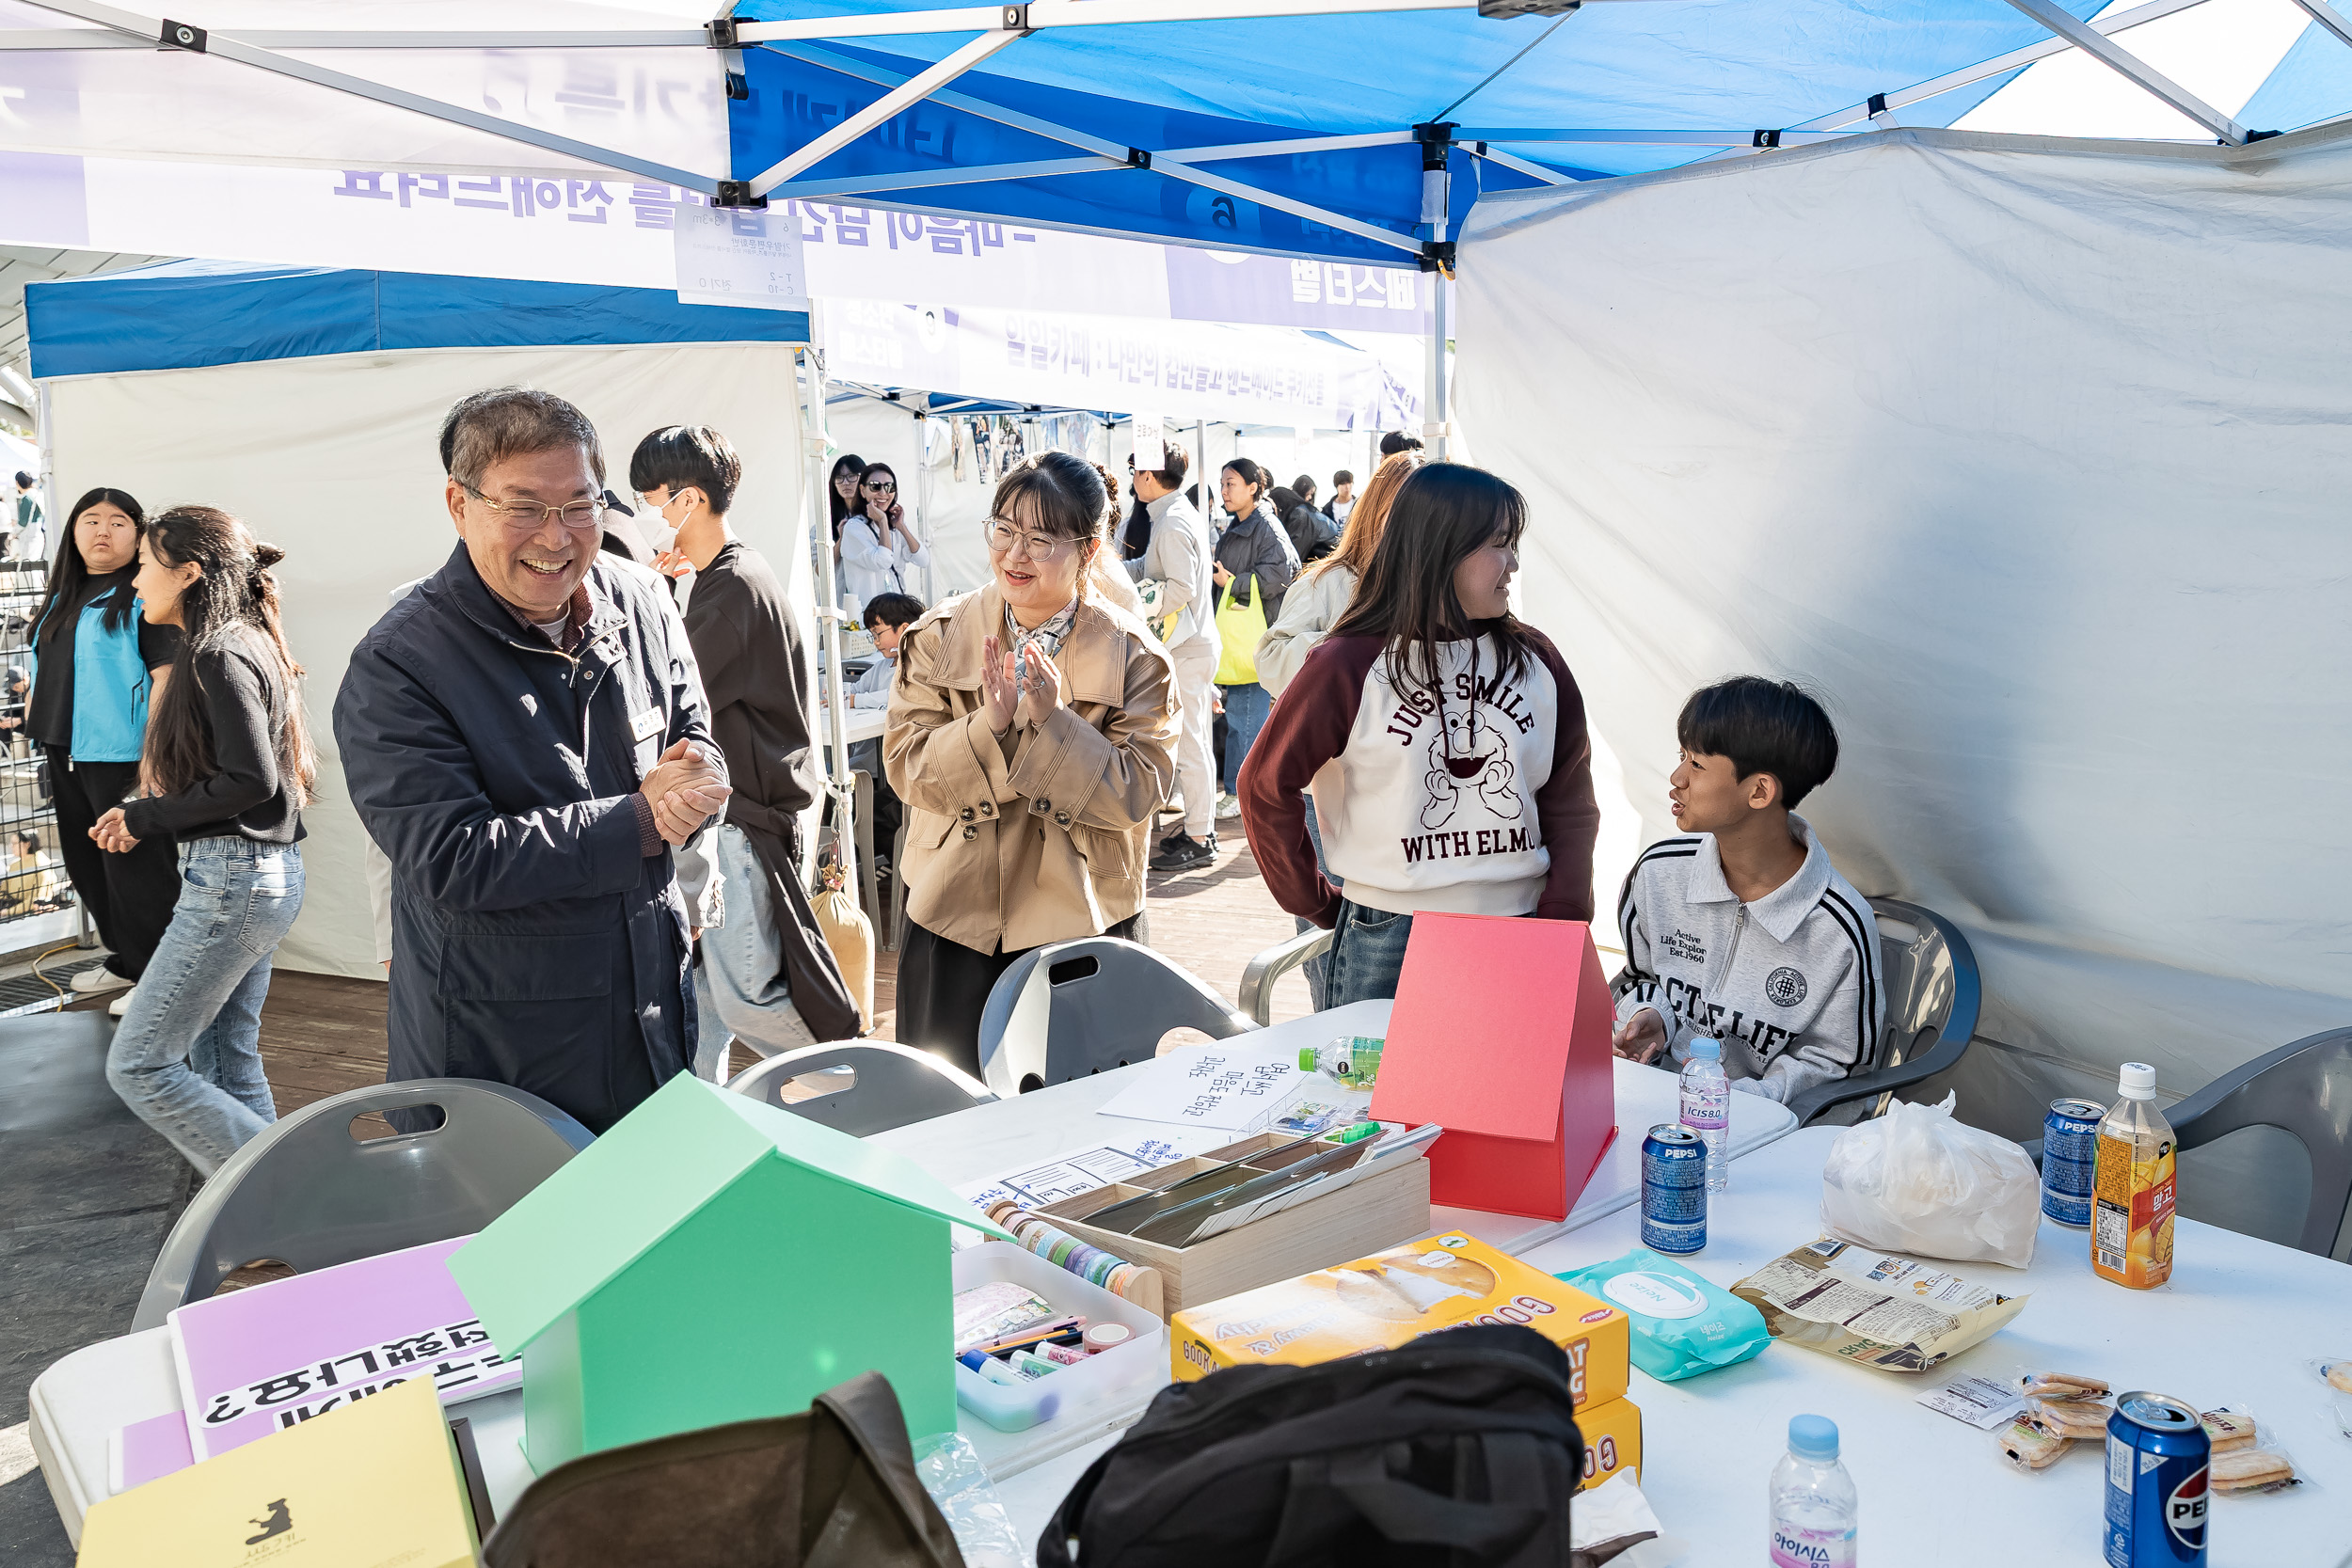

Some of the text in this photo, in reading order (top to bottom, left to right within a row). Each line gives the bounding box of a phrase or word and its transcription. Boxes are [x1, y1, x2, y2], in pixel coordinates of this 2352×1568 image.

[1005, 314, 1090, 378] 일일카페
[1107, 336, 1159, 387] 나만의
[1387, 673, 1535, 747] JUST SMILE
[1401, 826, 1536, 863] WITH ELM
[1660, 936, 1677, 946] Life
[1675, 928, 1701, 944] Active
[1790, 972, 1804, 987] ACTIVE
[1688, 1106, 1721, 1118] ICIS 8.0
[2064, 1121, 2097, 1134] PEPS
[1665, 1148, 1697, 1160] PEPSI
[2153, 1187, 2173, 1213] 망고
[1629, 1282, 1667, 1303] Neize
[1700, 1322, 1726, 1336] 네이즈
[1774, 1531, 1831, 1562] 아이시스
